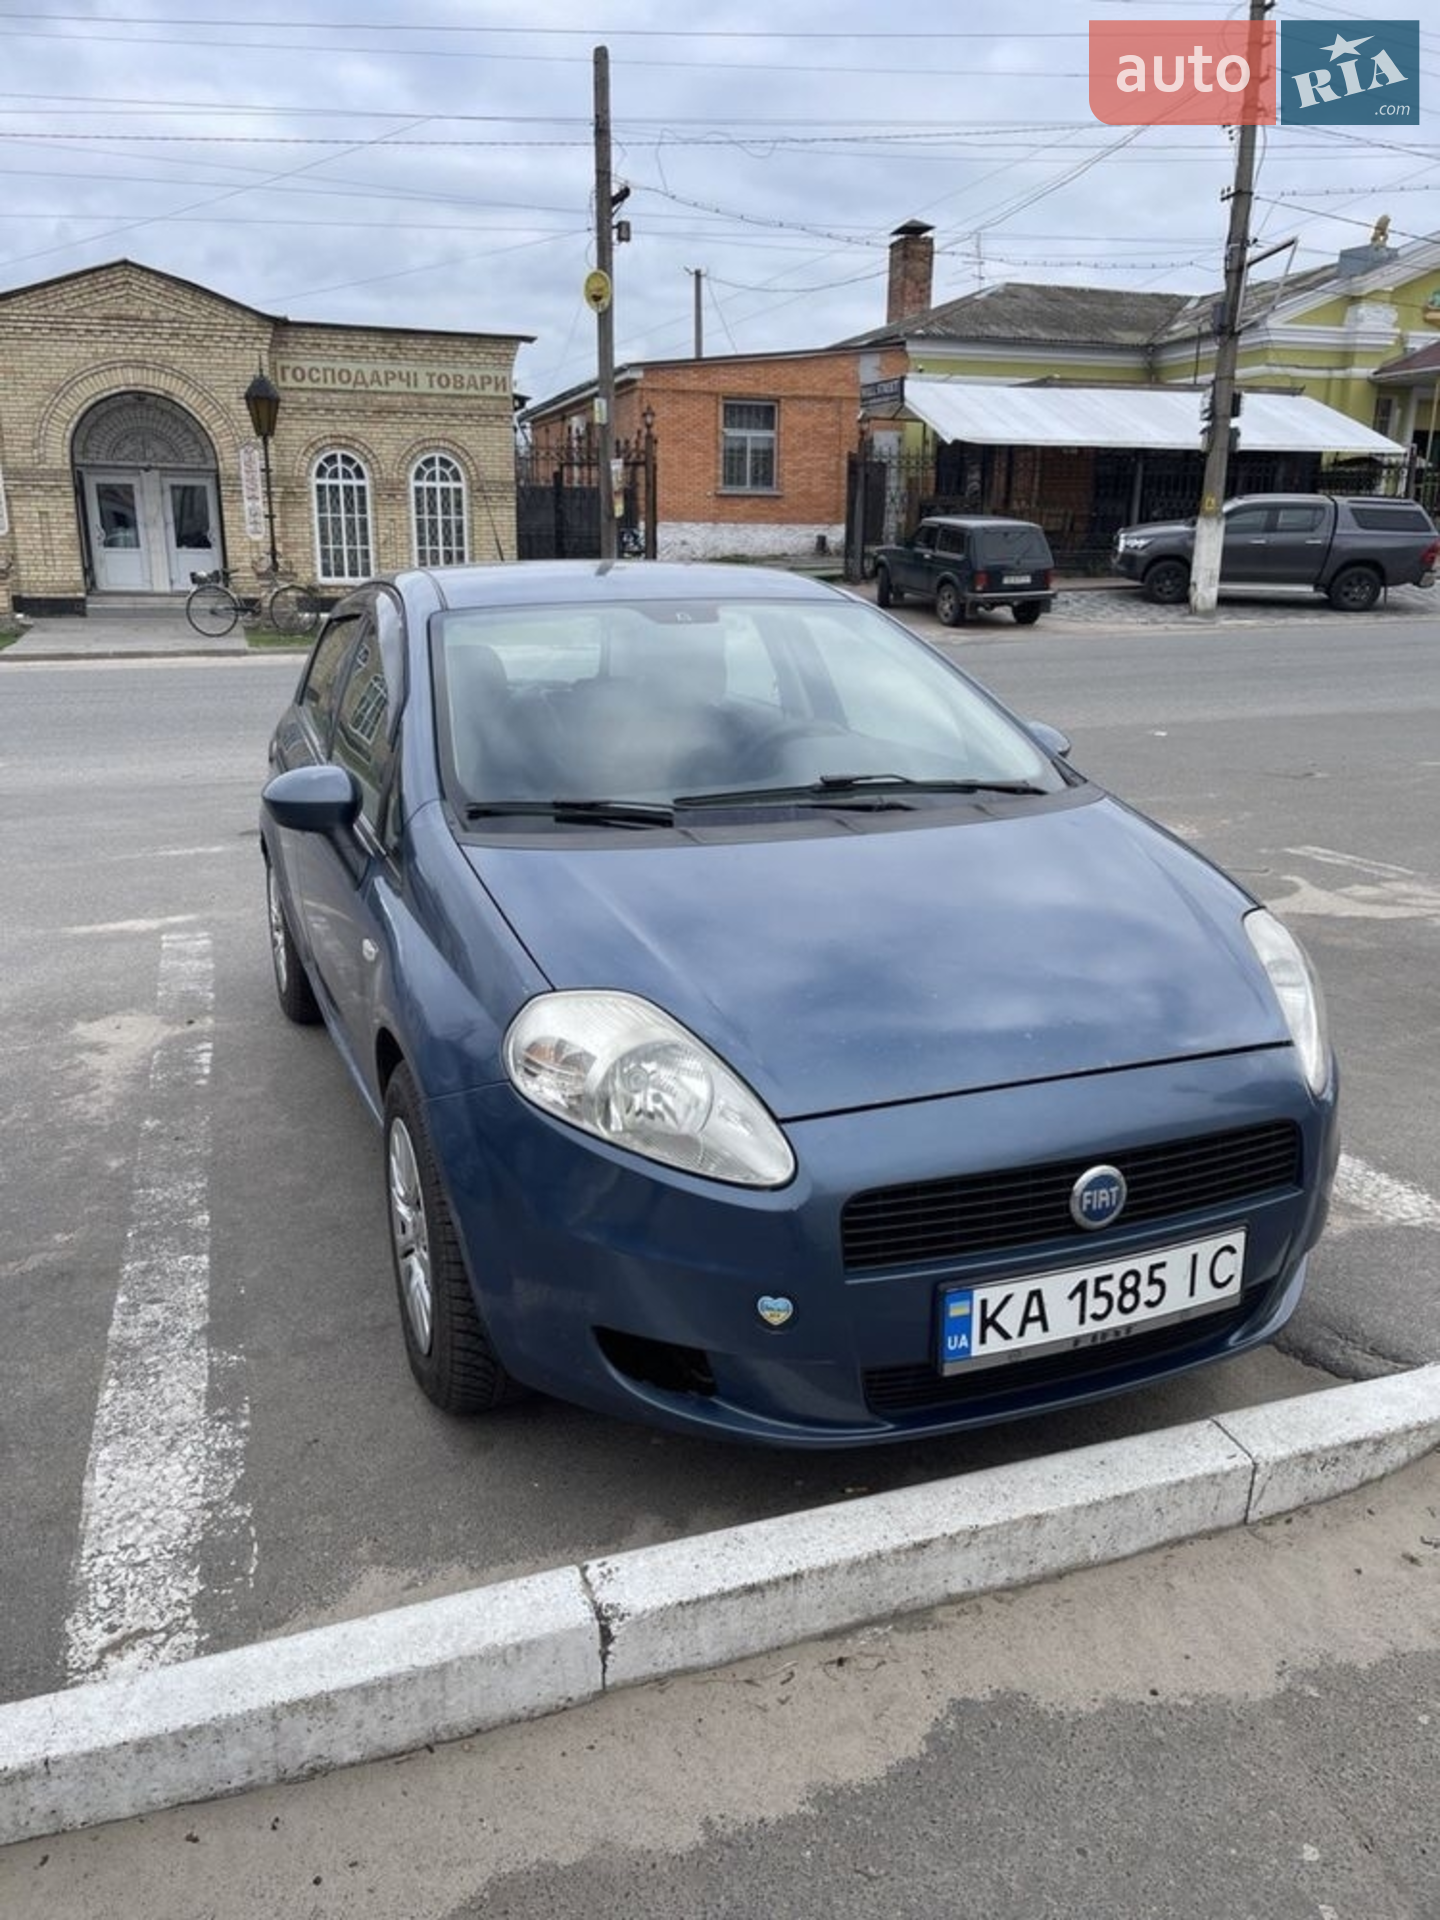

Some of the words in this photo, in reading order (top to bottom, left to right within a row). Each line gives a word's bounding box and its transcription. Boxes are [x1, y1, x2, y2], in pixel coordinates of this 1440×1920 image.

[279, 365, 418, 389] ГОСПОДАРЧІ
[425, 371, 508, 392] ТОВАРИ
[1082, 1185, 1120, 1213] FIAT
[978, 1288, 1050, 1345] KA
[1067, 1261, 1167, 1326] 1585
[1187, 1244, 1238, 1298] IC
[947, 1334, 969, 1350] UA
